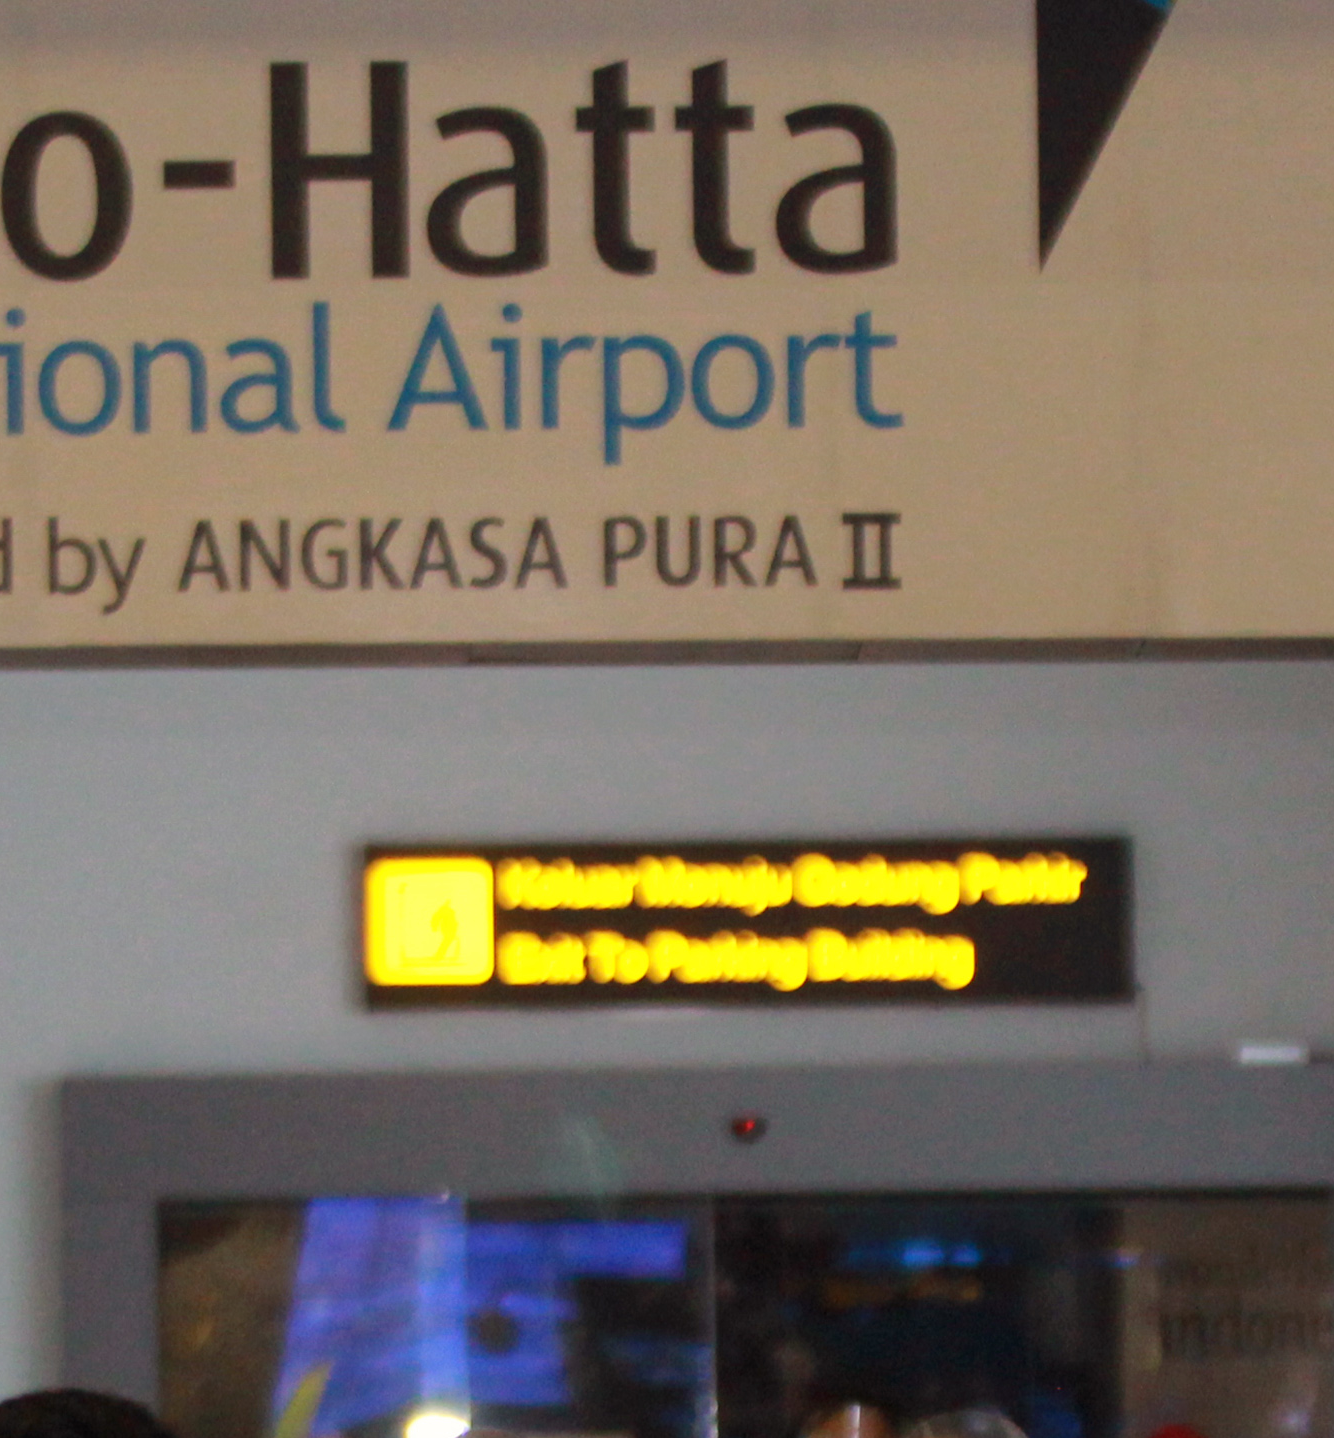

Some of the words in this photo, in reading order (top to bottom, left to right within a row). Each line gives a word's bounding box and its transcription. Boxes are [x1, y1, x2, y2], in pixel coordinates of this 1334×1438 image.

[386, 303, 903, 466] Airport
[45, 516, 146, 615] by
[177, 516, 567, 592] ANGKASA
[602, 514, 817, 587] PURA
[840, 512, 901, 590] II
[587, 931, 648, 984] To
